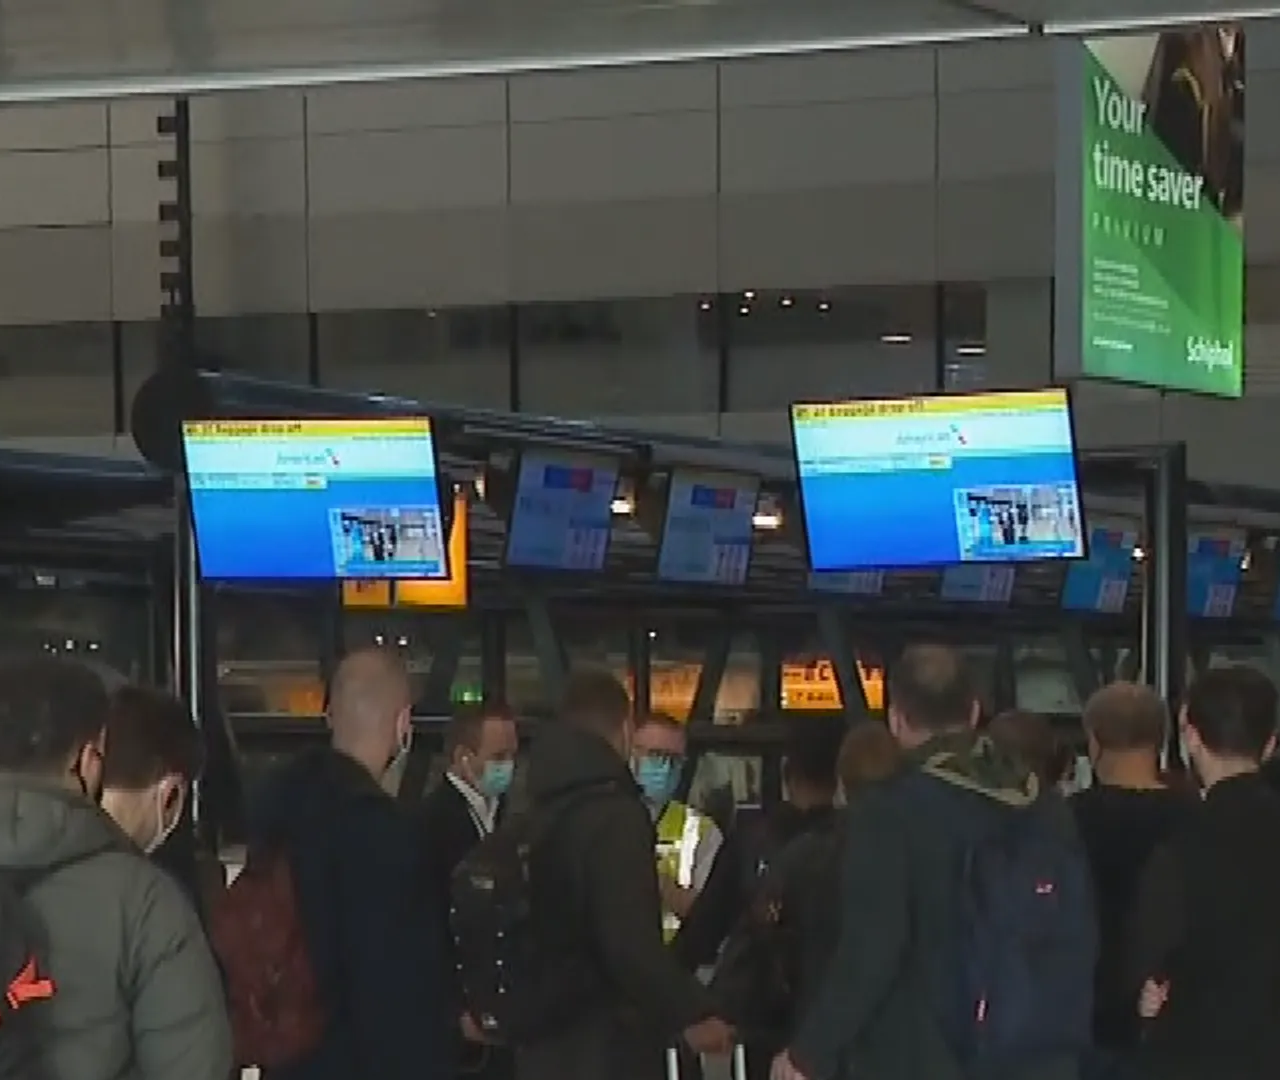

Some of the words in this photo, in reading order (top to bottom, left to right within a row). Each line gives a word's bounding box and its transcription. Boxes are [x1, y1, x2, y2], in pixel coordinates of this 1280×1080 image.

[1093, 76, 1147, 135] Your
[1093, 141, 1143, 198] time
[1147, 162, 1204, 210] saver
[1186, 336, 1234, 371] Schiphol
